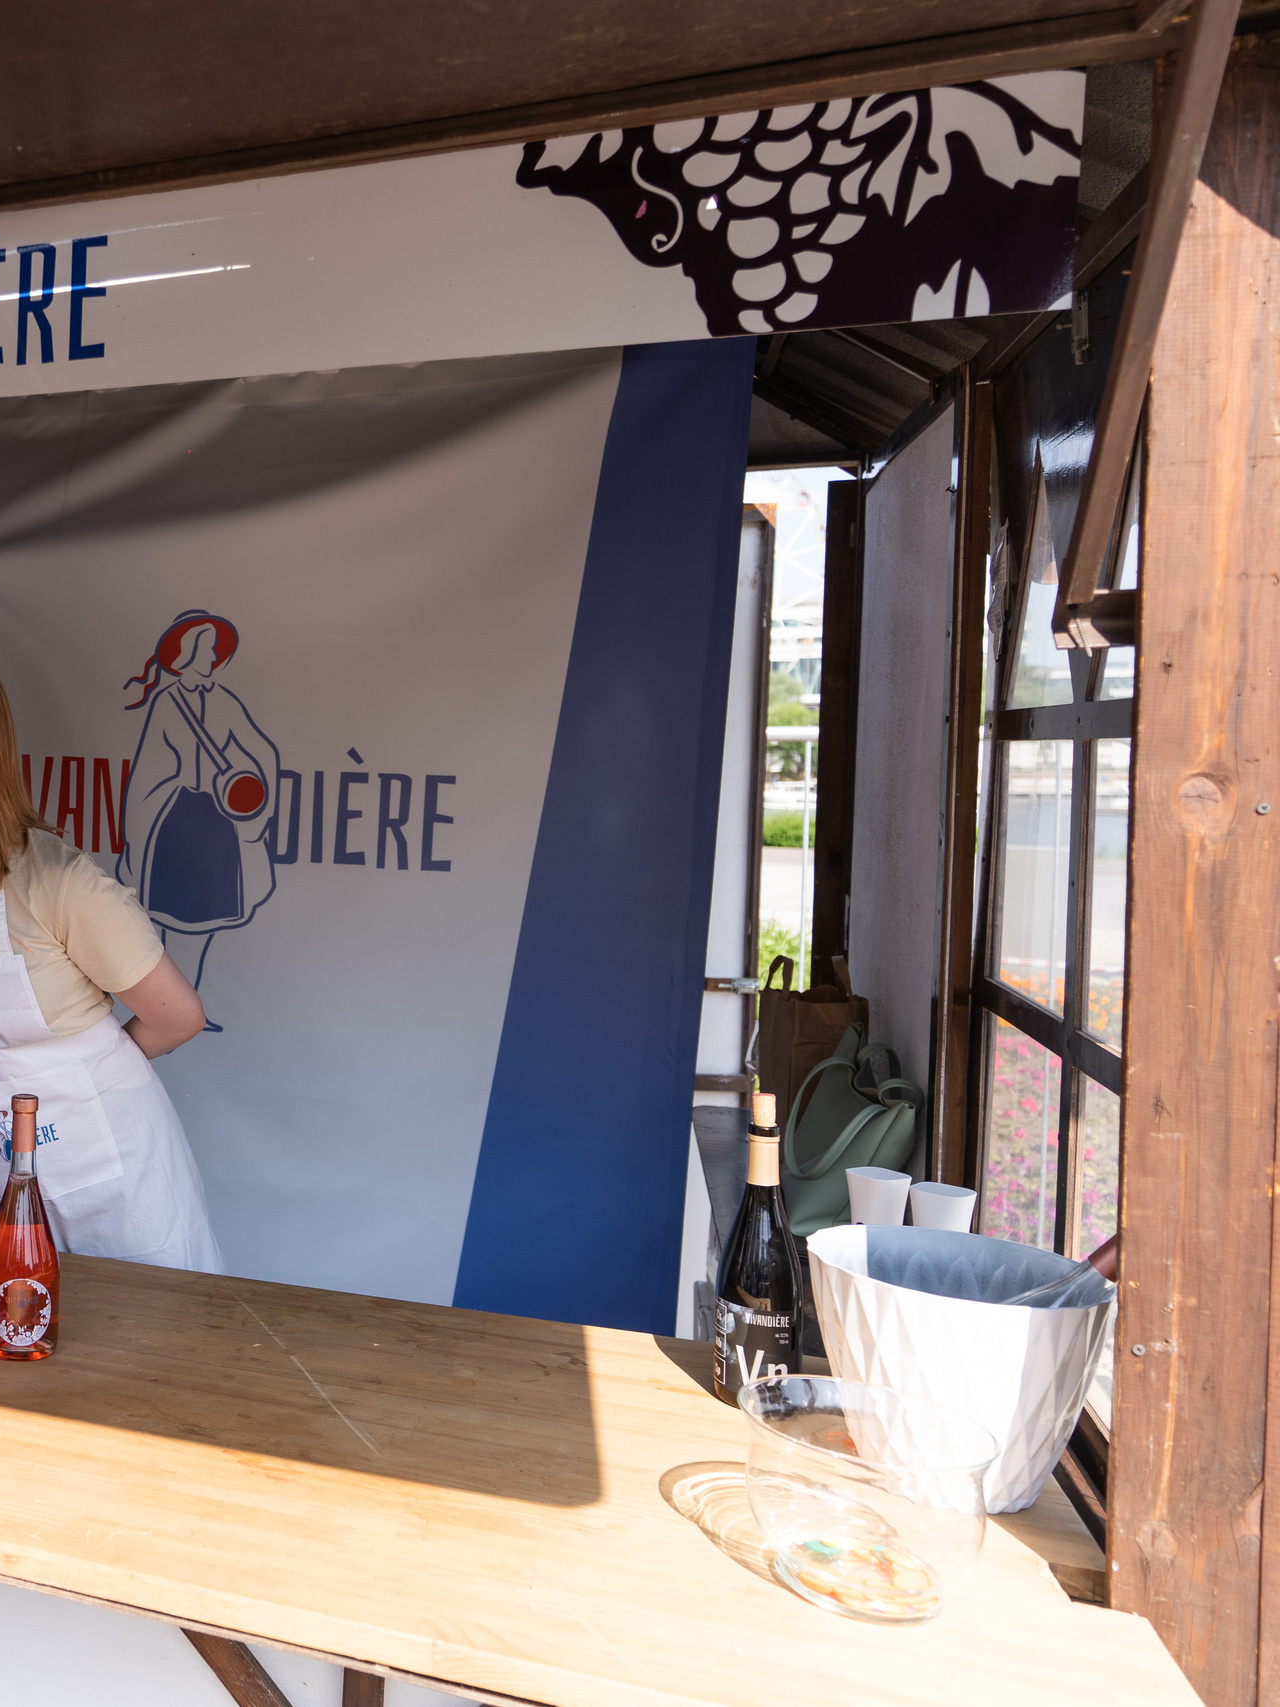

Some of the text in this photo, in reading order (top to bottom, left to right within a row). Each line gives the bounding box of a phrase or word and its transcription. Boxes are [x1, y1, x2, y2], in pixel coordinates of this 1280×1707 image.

[21, 747, 456, 872] VAN DIÈRE
[745, 1312, 790, 1328] VIVANDIÈRE
